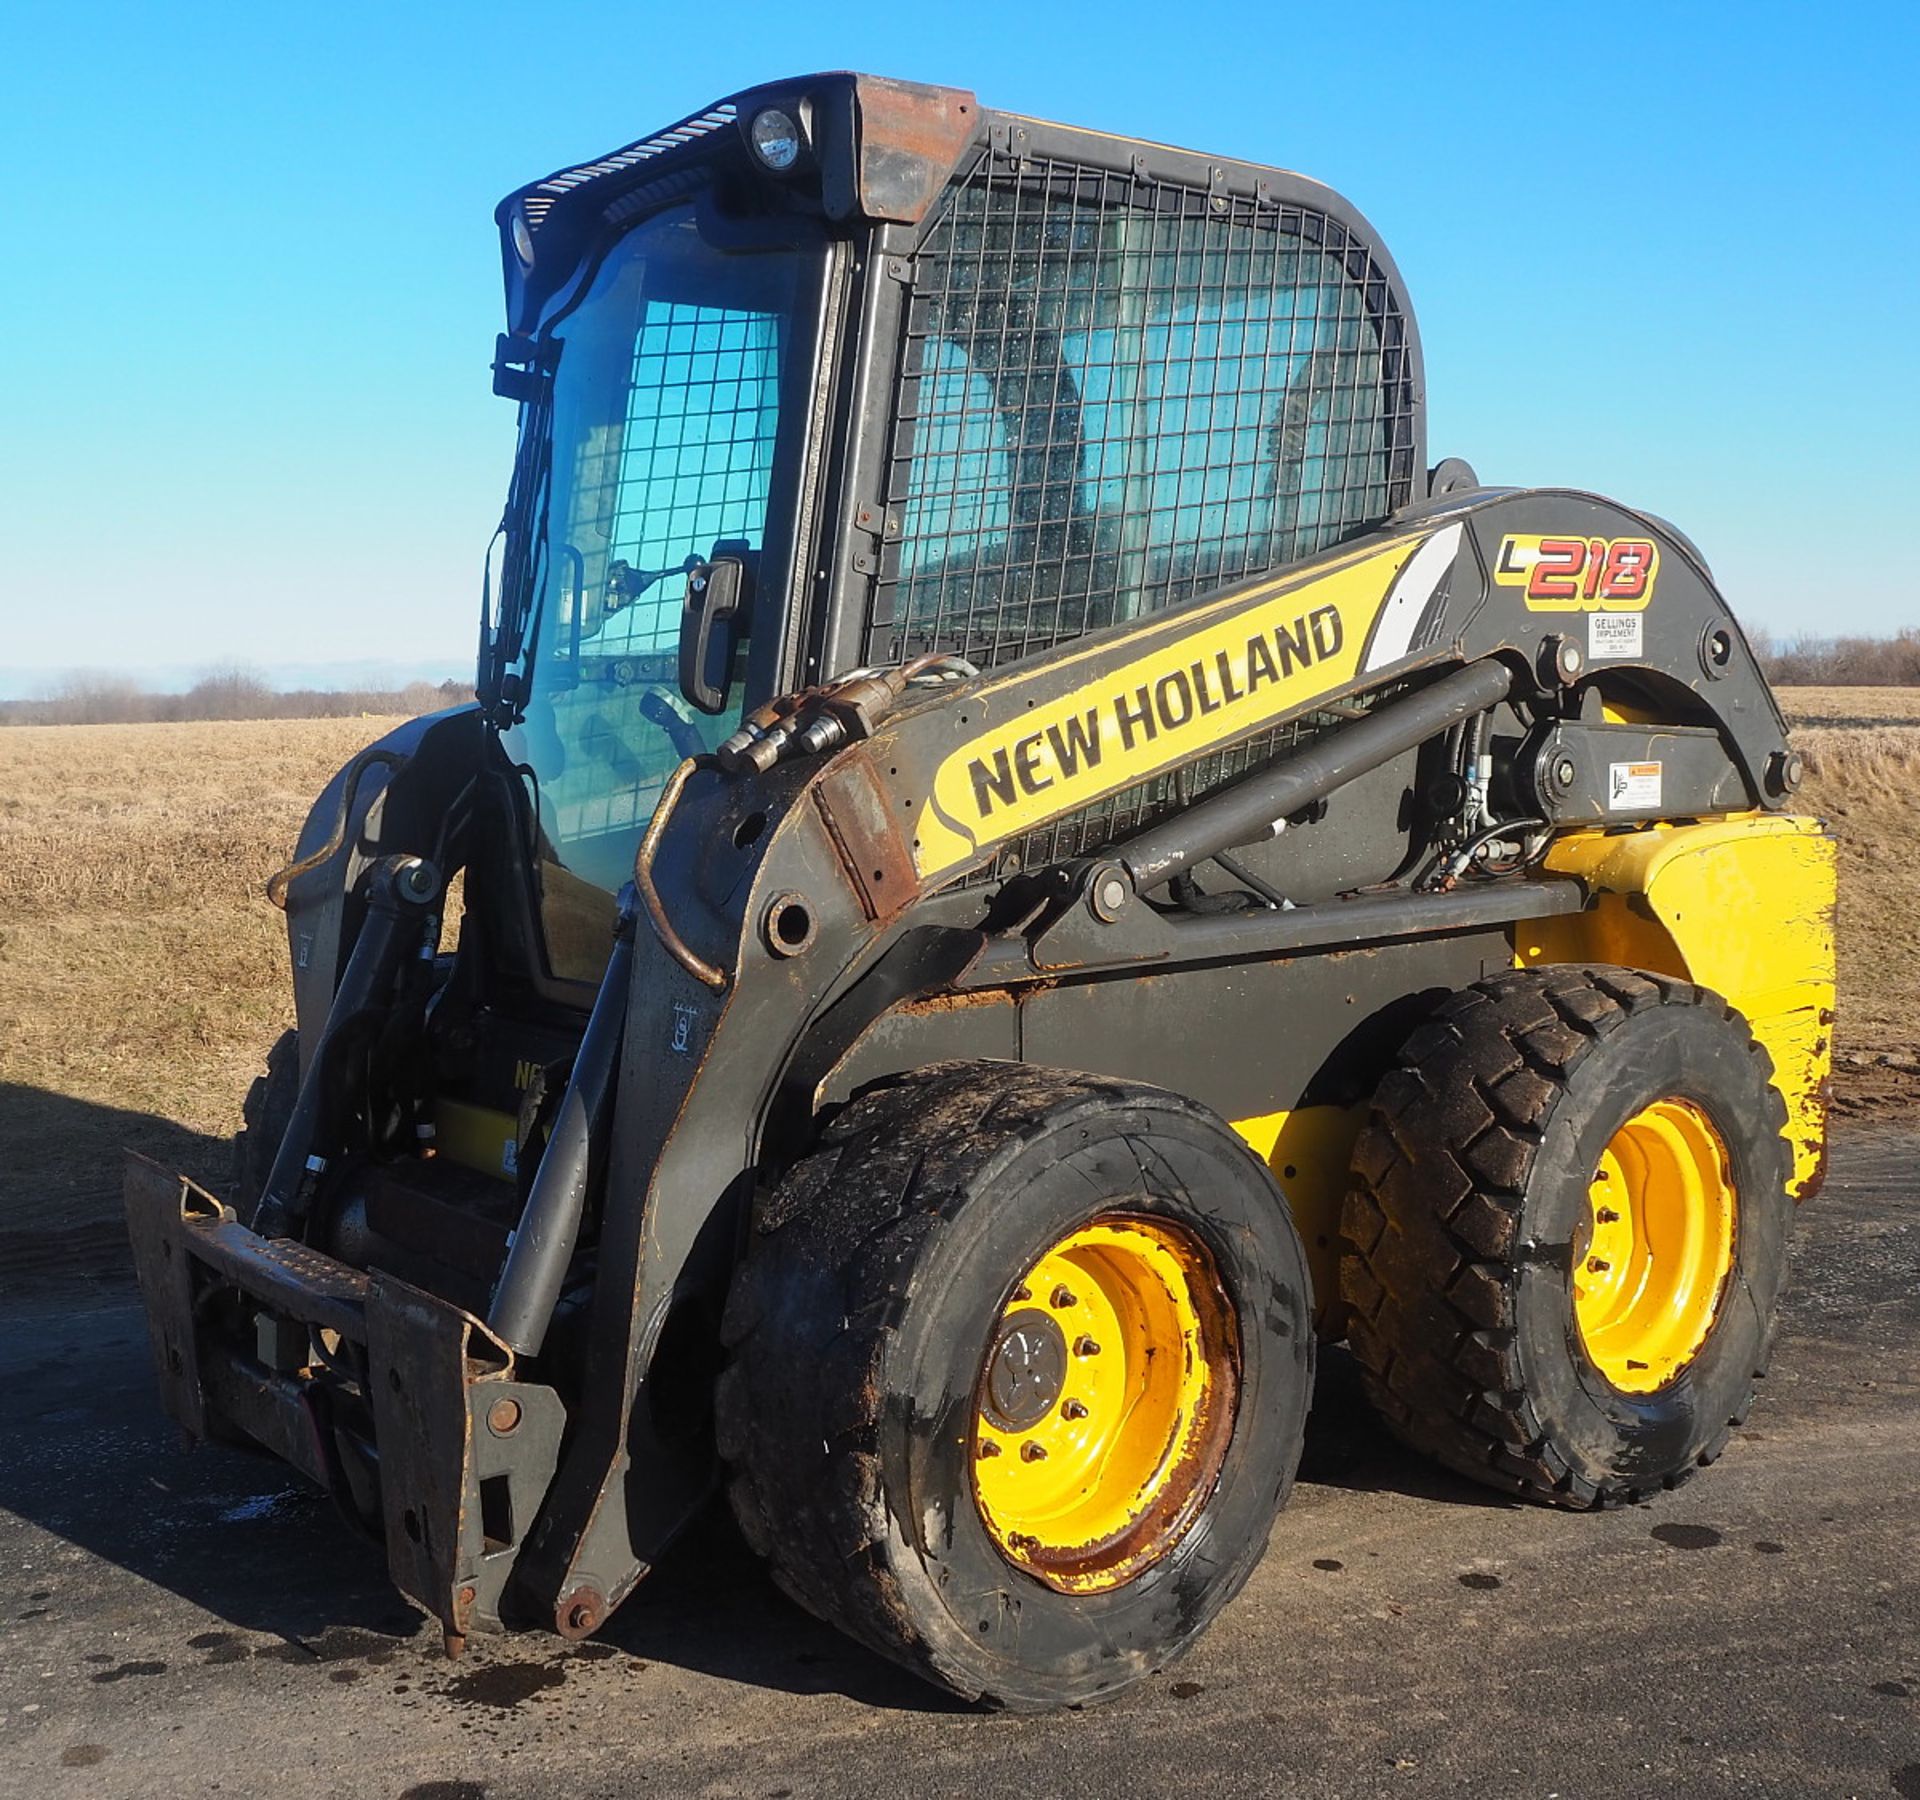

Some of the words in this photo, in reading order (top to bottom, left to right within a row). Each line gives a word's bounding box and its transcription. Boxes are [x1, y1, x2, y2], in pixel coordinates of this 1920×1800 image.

[1498, 539, 1653, 600] L218
[1595, 618, 1636, 629] GELLINGS
[967, 706, 1102, 818] NEW
[1113, 603, 1343, 752] HOLLAND
